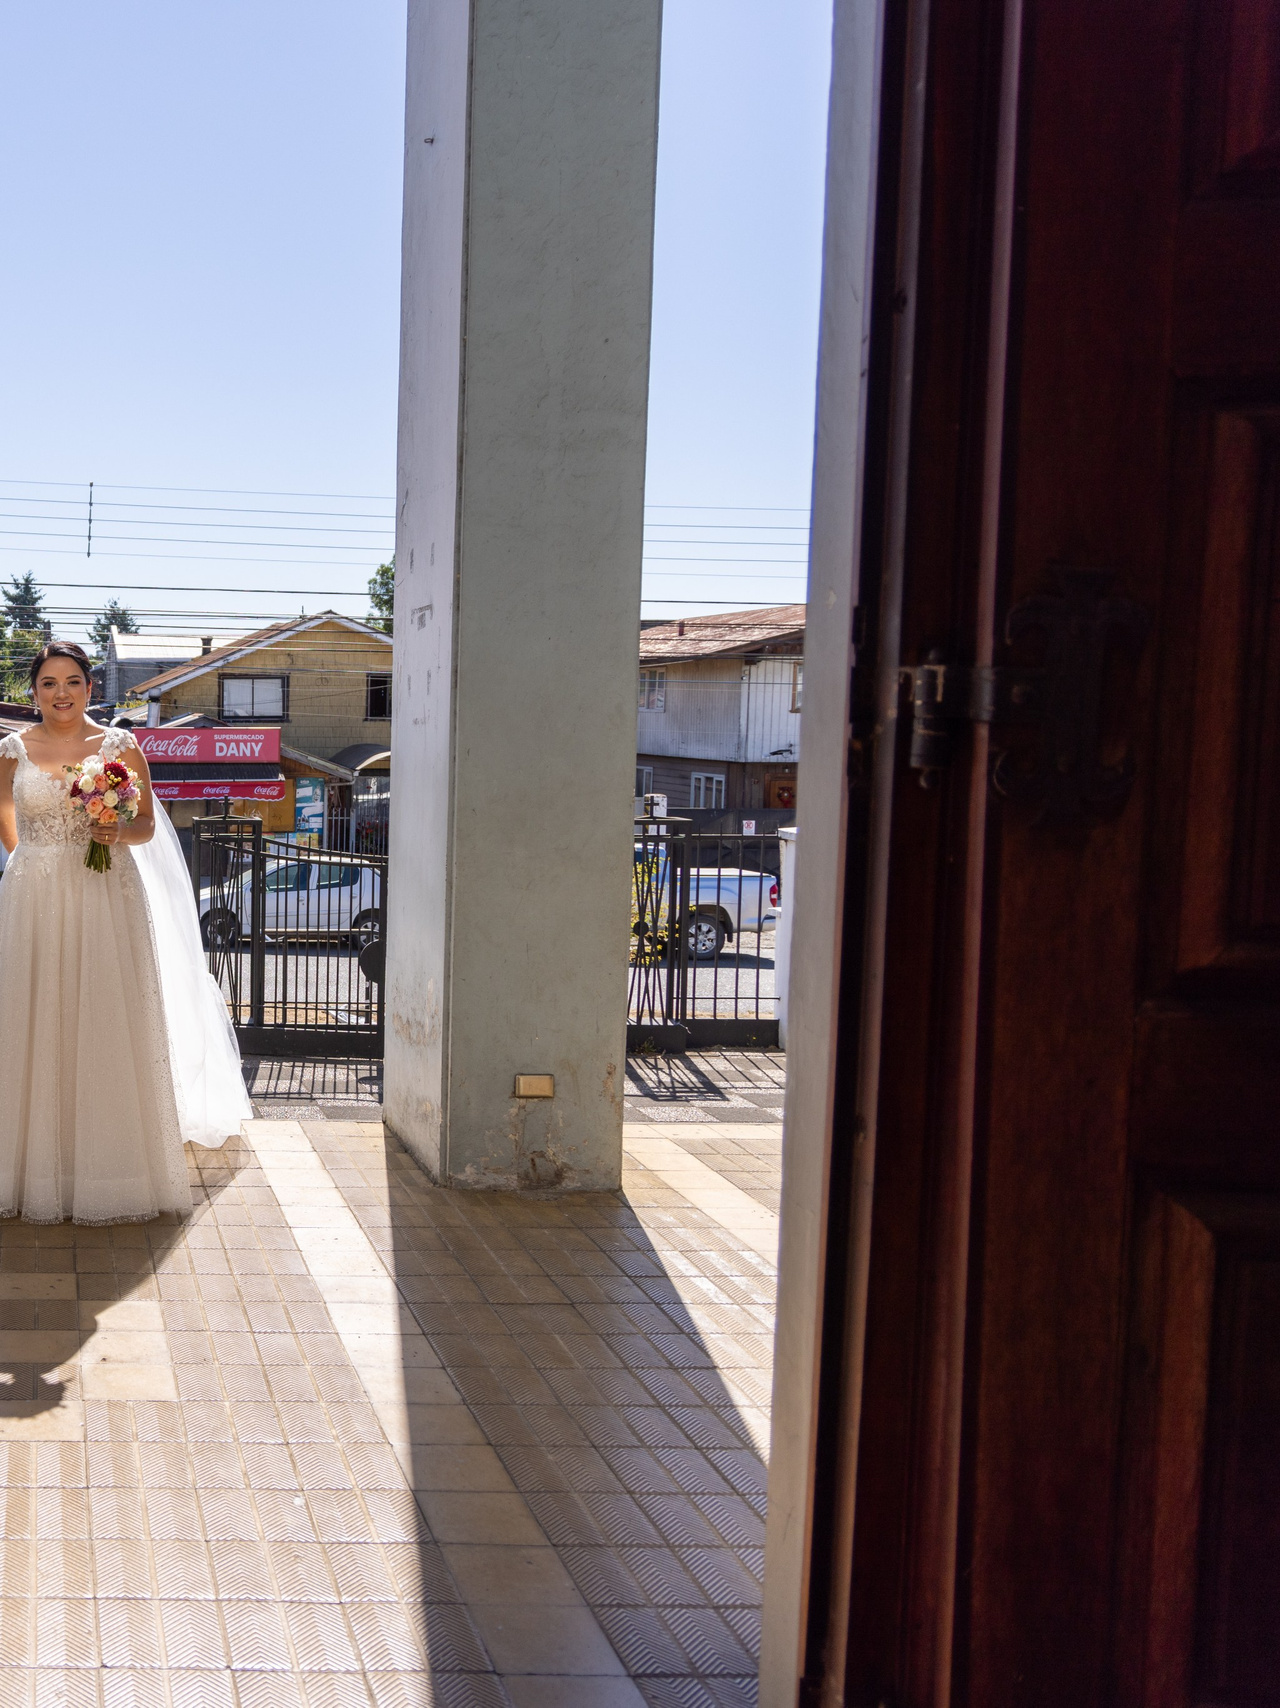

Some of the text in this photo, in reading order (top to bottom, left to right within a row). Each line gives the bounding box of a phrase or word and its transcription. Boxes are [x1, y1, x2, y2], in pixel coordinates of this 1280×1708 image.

[140, 735, 201, 756] Coca-Cola
[215, 742, 263, 757] DANY
[203, 786, 230, 794] Coca-Cola
[254, 786, 280, 795] Coca-Cola
